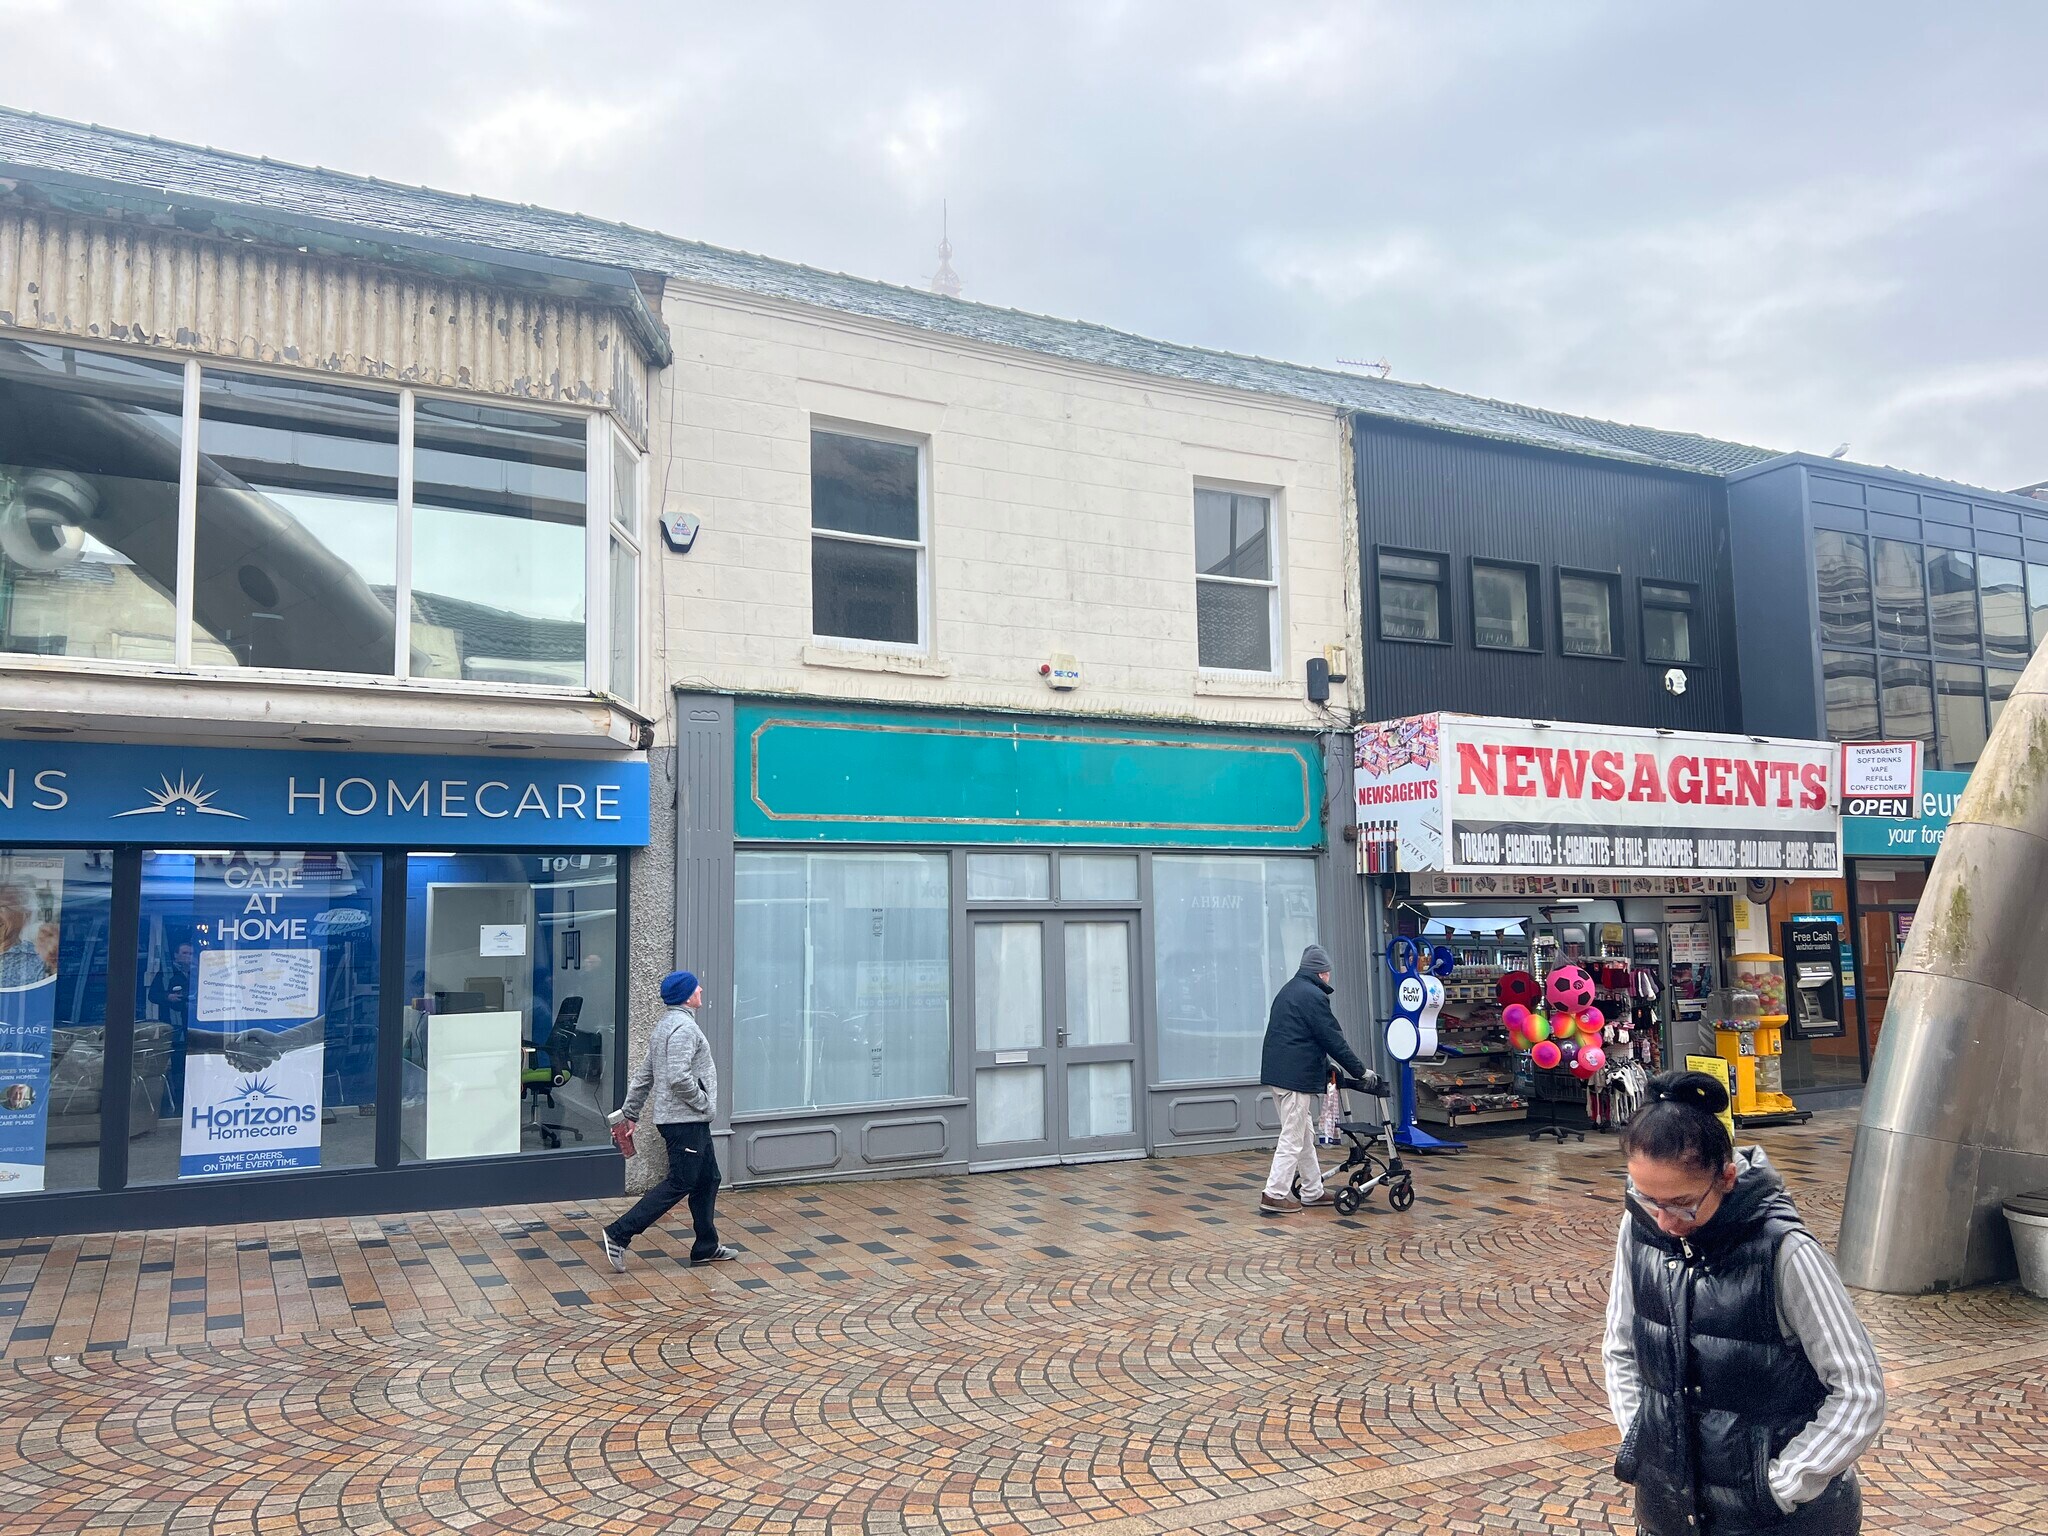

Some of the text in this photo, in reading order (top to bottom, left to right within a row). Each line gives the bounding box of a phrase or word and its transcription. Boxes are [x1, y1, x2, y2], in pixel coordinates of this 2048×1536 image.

[1054, 670, 1079, 678] SECOM
[1856, 747, 1903, 755] NEWSAGENTS
[1456, 742, 1828, 811] NEWSAGENTS
[287, 775, 623, 823] HOMECARE
[1358, 779, 1439, 806] NEWSAGENTS
[1848, 799, 1907, 816] OPEN
[1887, 825, 1948, 847] your fore
[1459, 832, 1500, 864] TOBACCO
[1505, 833, 1552, 865] CIGARETTES
[1647, 838, 1694, 867] NEWSPAPERS
[1698, 839, 1736, 868] MAGAZINES
[1740, 840, 1757, 868] COLD
[1757, 840, 1782, 868] DRINKS
[1785, 841, 1809, 869] CRISPS
[1812, 842, 1837, 869] SWEETS
[223, 866, 304, 889] CARE
[243, 893, 283, 915] AT
[217, 918, 308, 941] HOME
[1792, 930, 1833, 942] Free Cash
[1795, 942, 1831, 951] withdrawals
[270, 951, 297, 960] Dementia
[237, 967, 264, 976] Shopping
[203, 980, 246, 990] Companionship
[1403, 986, 1420, 994] PLAY
[1403, 994, 1420, 1002] NOW
[191, 1102, 317, 1129] Horizons
[208, 1125, 298, 1140] Homecare
[218, 1151, 285, 1163] SAME CARERS.
[203, 1163, 219, 1172] ON
[245, 1159, 275, 1169] EVERY
